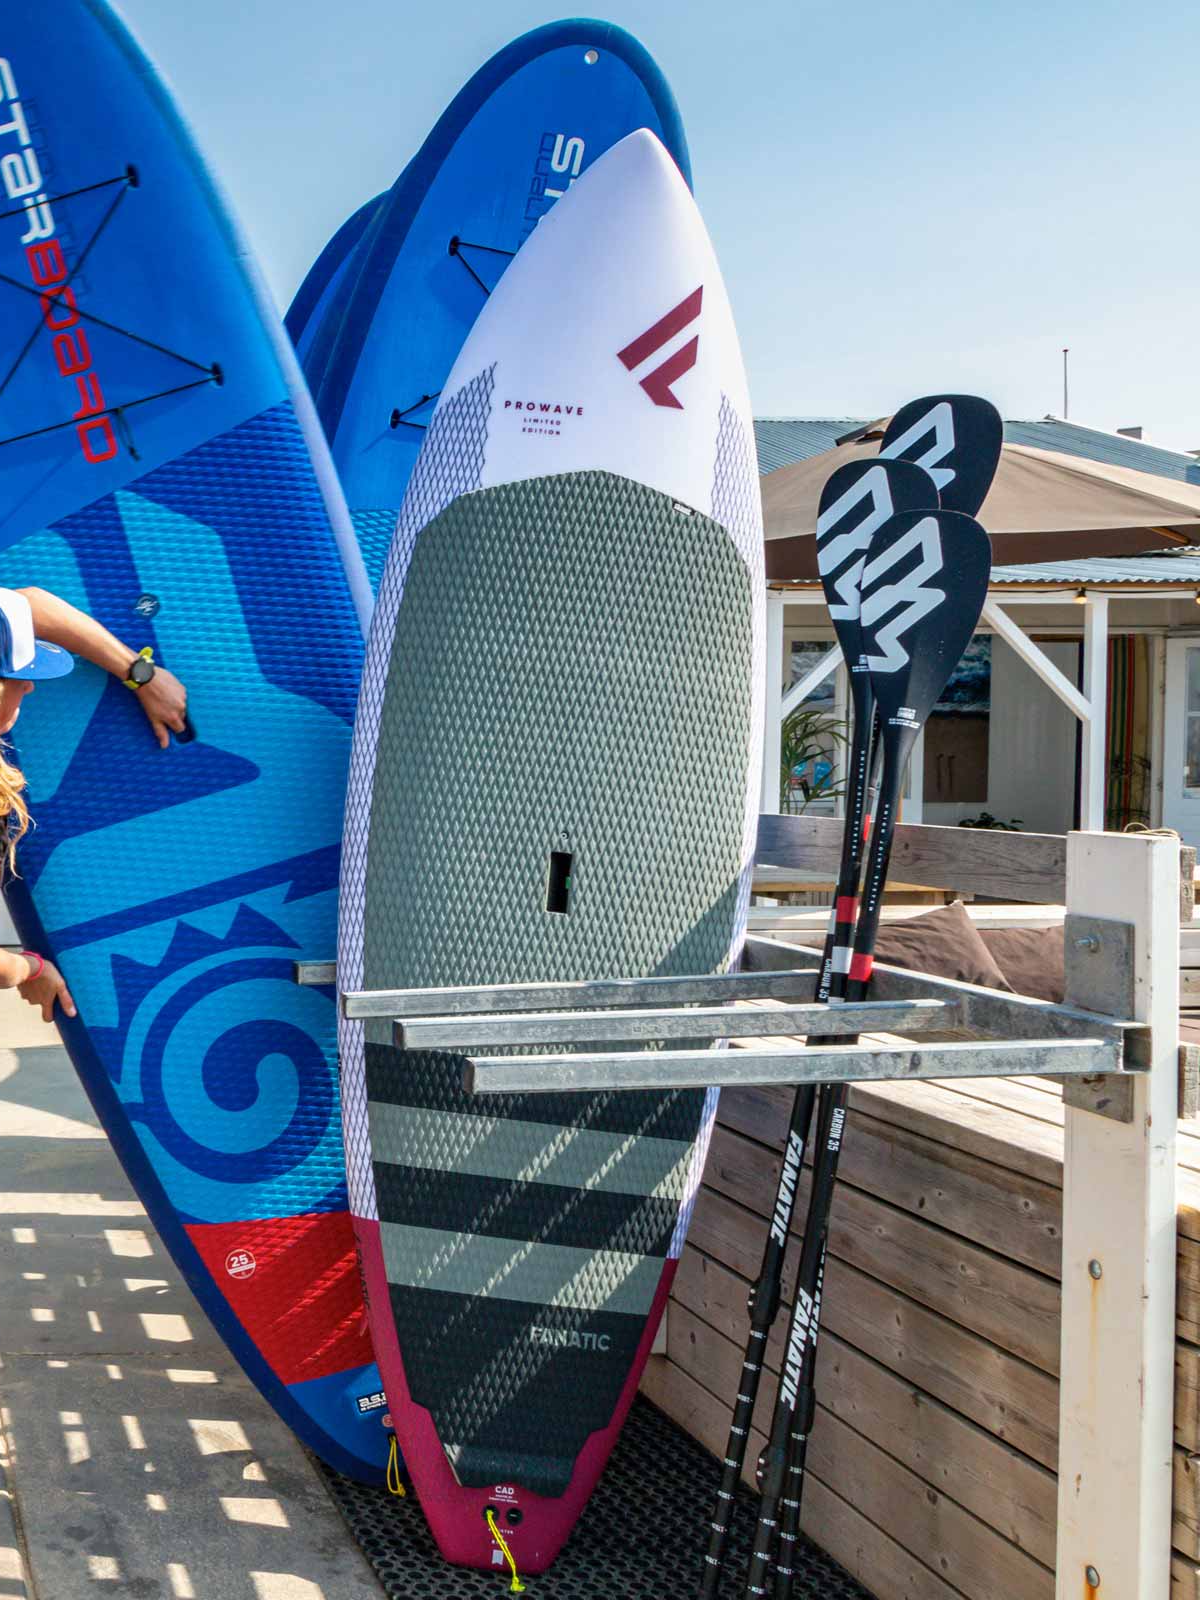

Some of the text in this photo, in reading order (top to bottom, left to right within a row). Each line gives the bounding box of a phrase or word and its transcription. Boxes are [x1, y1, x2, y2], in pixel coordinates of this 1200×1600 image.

[504, 400, 583, 416] PROWAVE
[523, 418, 561, 426] LIMITED
[522, 427, 560, 435] EDITION
[827, 1107, 845, 1152] CARBON 35
[770, 1129, 803, 1247] FANATIC
[230, 1253, 249, 1268] 25
[530, 1325, 611, 1351] FANATIC
[780, 1287, 813, 1412] FANATIC
[495, 1485, 515, 1495] CAD
